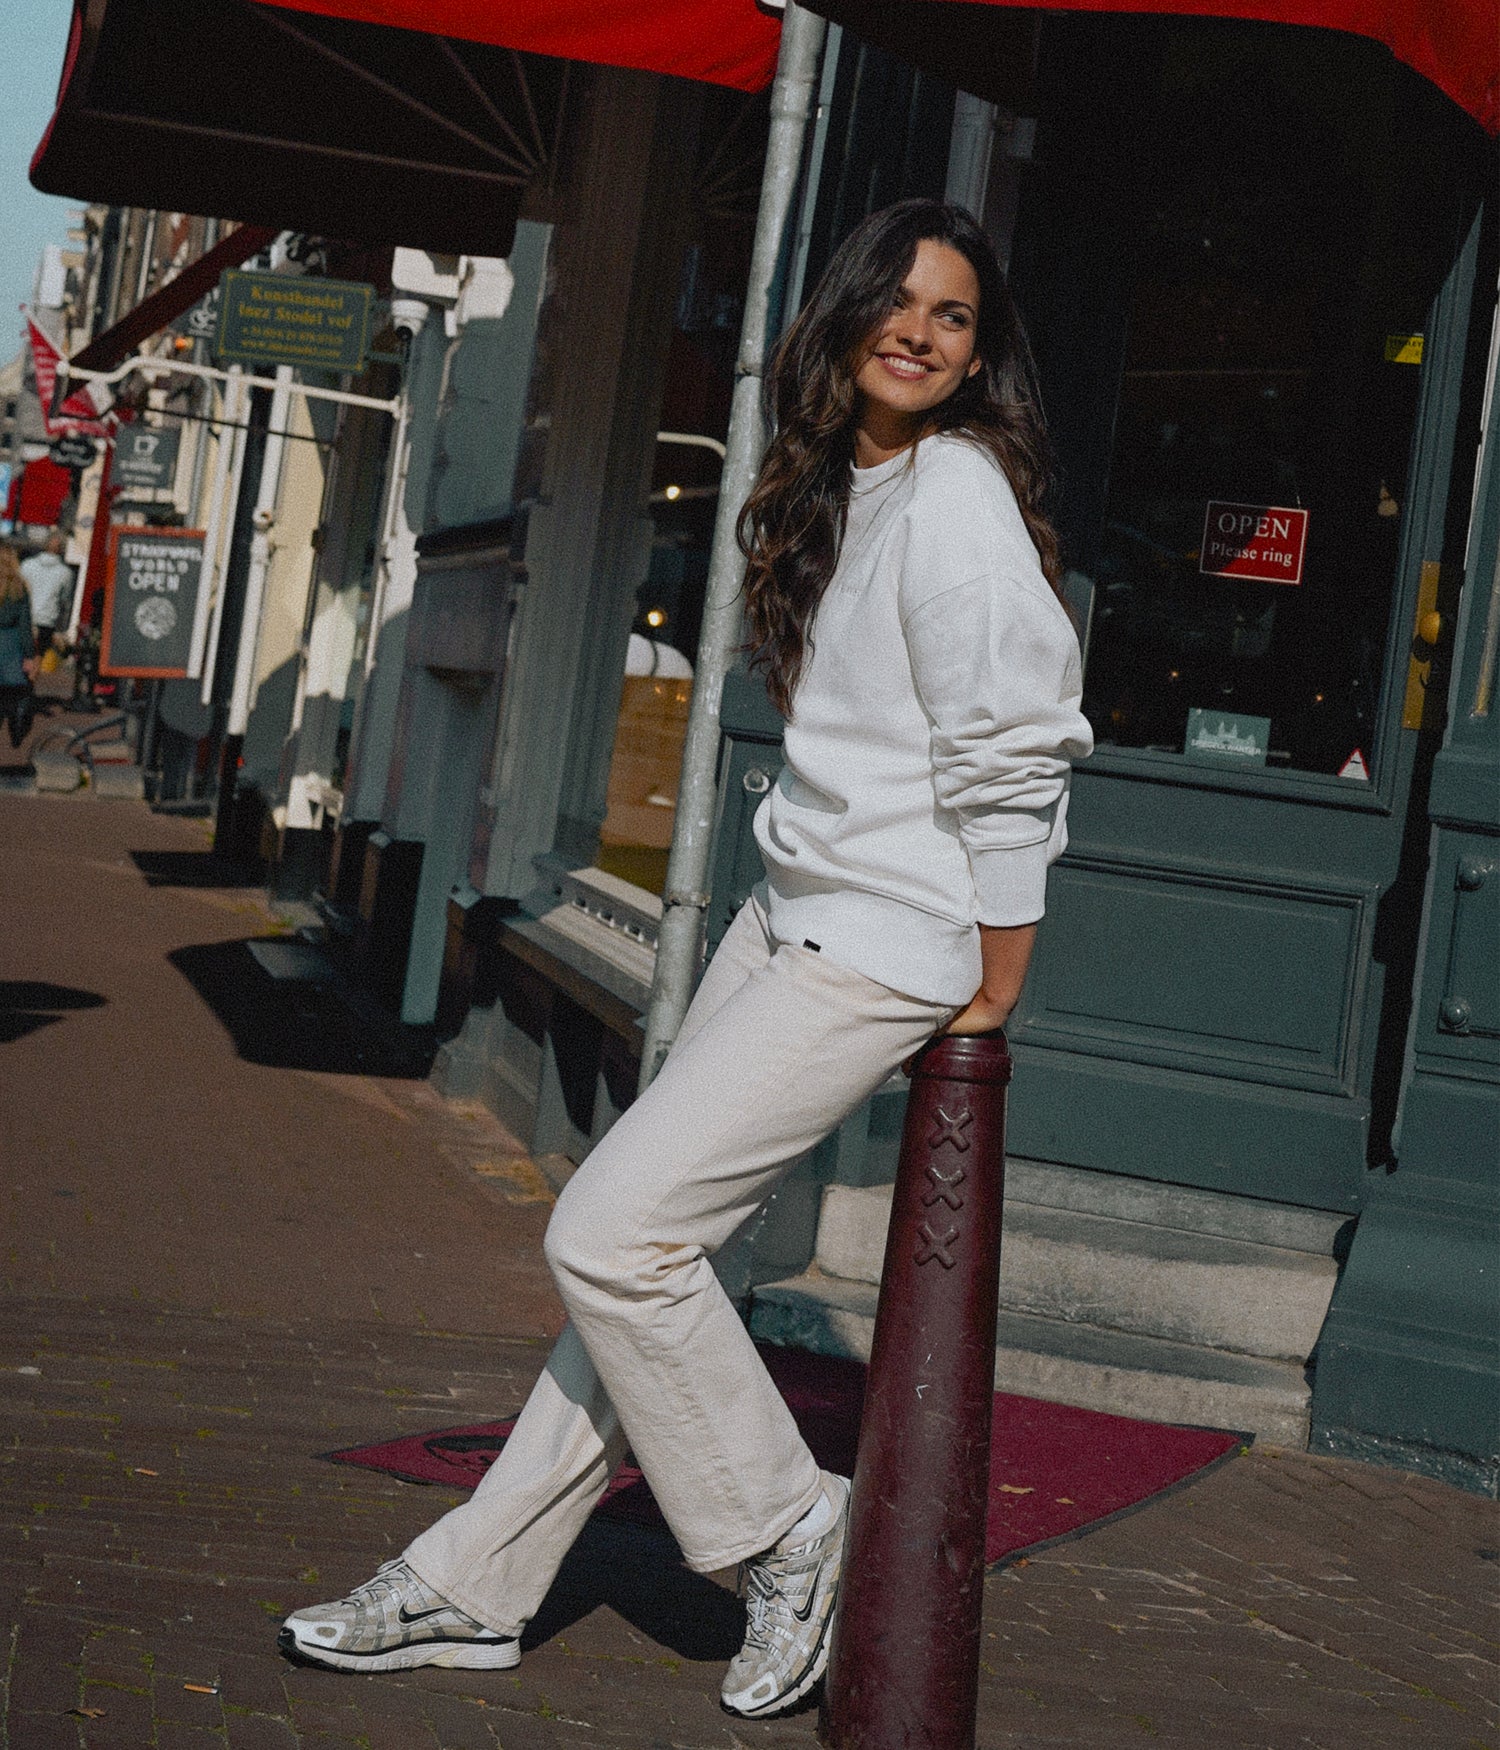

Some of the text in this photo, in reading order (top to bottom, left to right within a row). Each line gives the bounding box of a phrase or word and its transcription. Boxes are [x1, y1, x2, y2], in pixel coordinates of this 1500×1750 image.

[251, 286, 344, 309] Kunsthandel
[1218, 512, 1291, 539] OPEN
[1210, 542, 1293, 567] Please ring
[128, 571, 180, 592] OPEN
